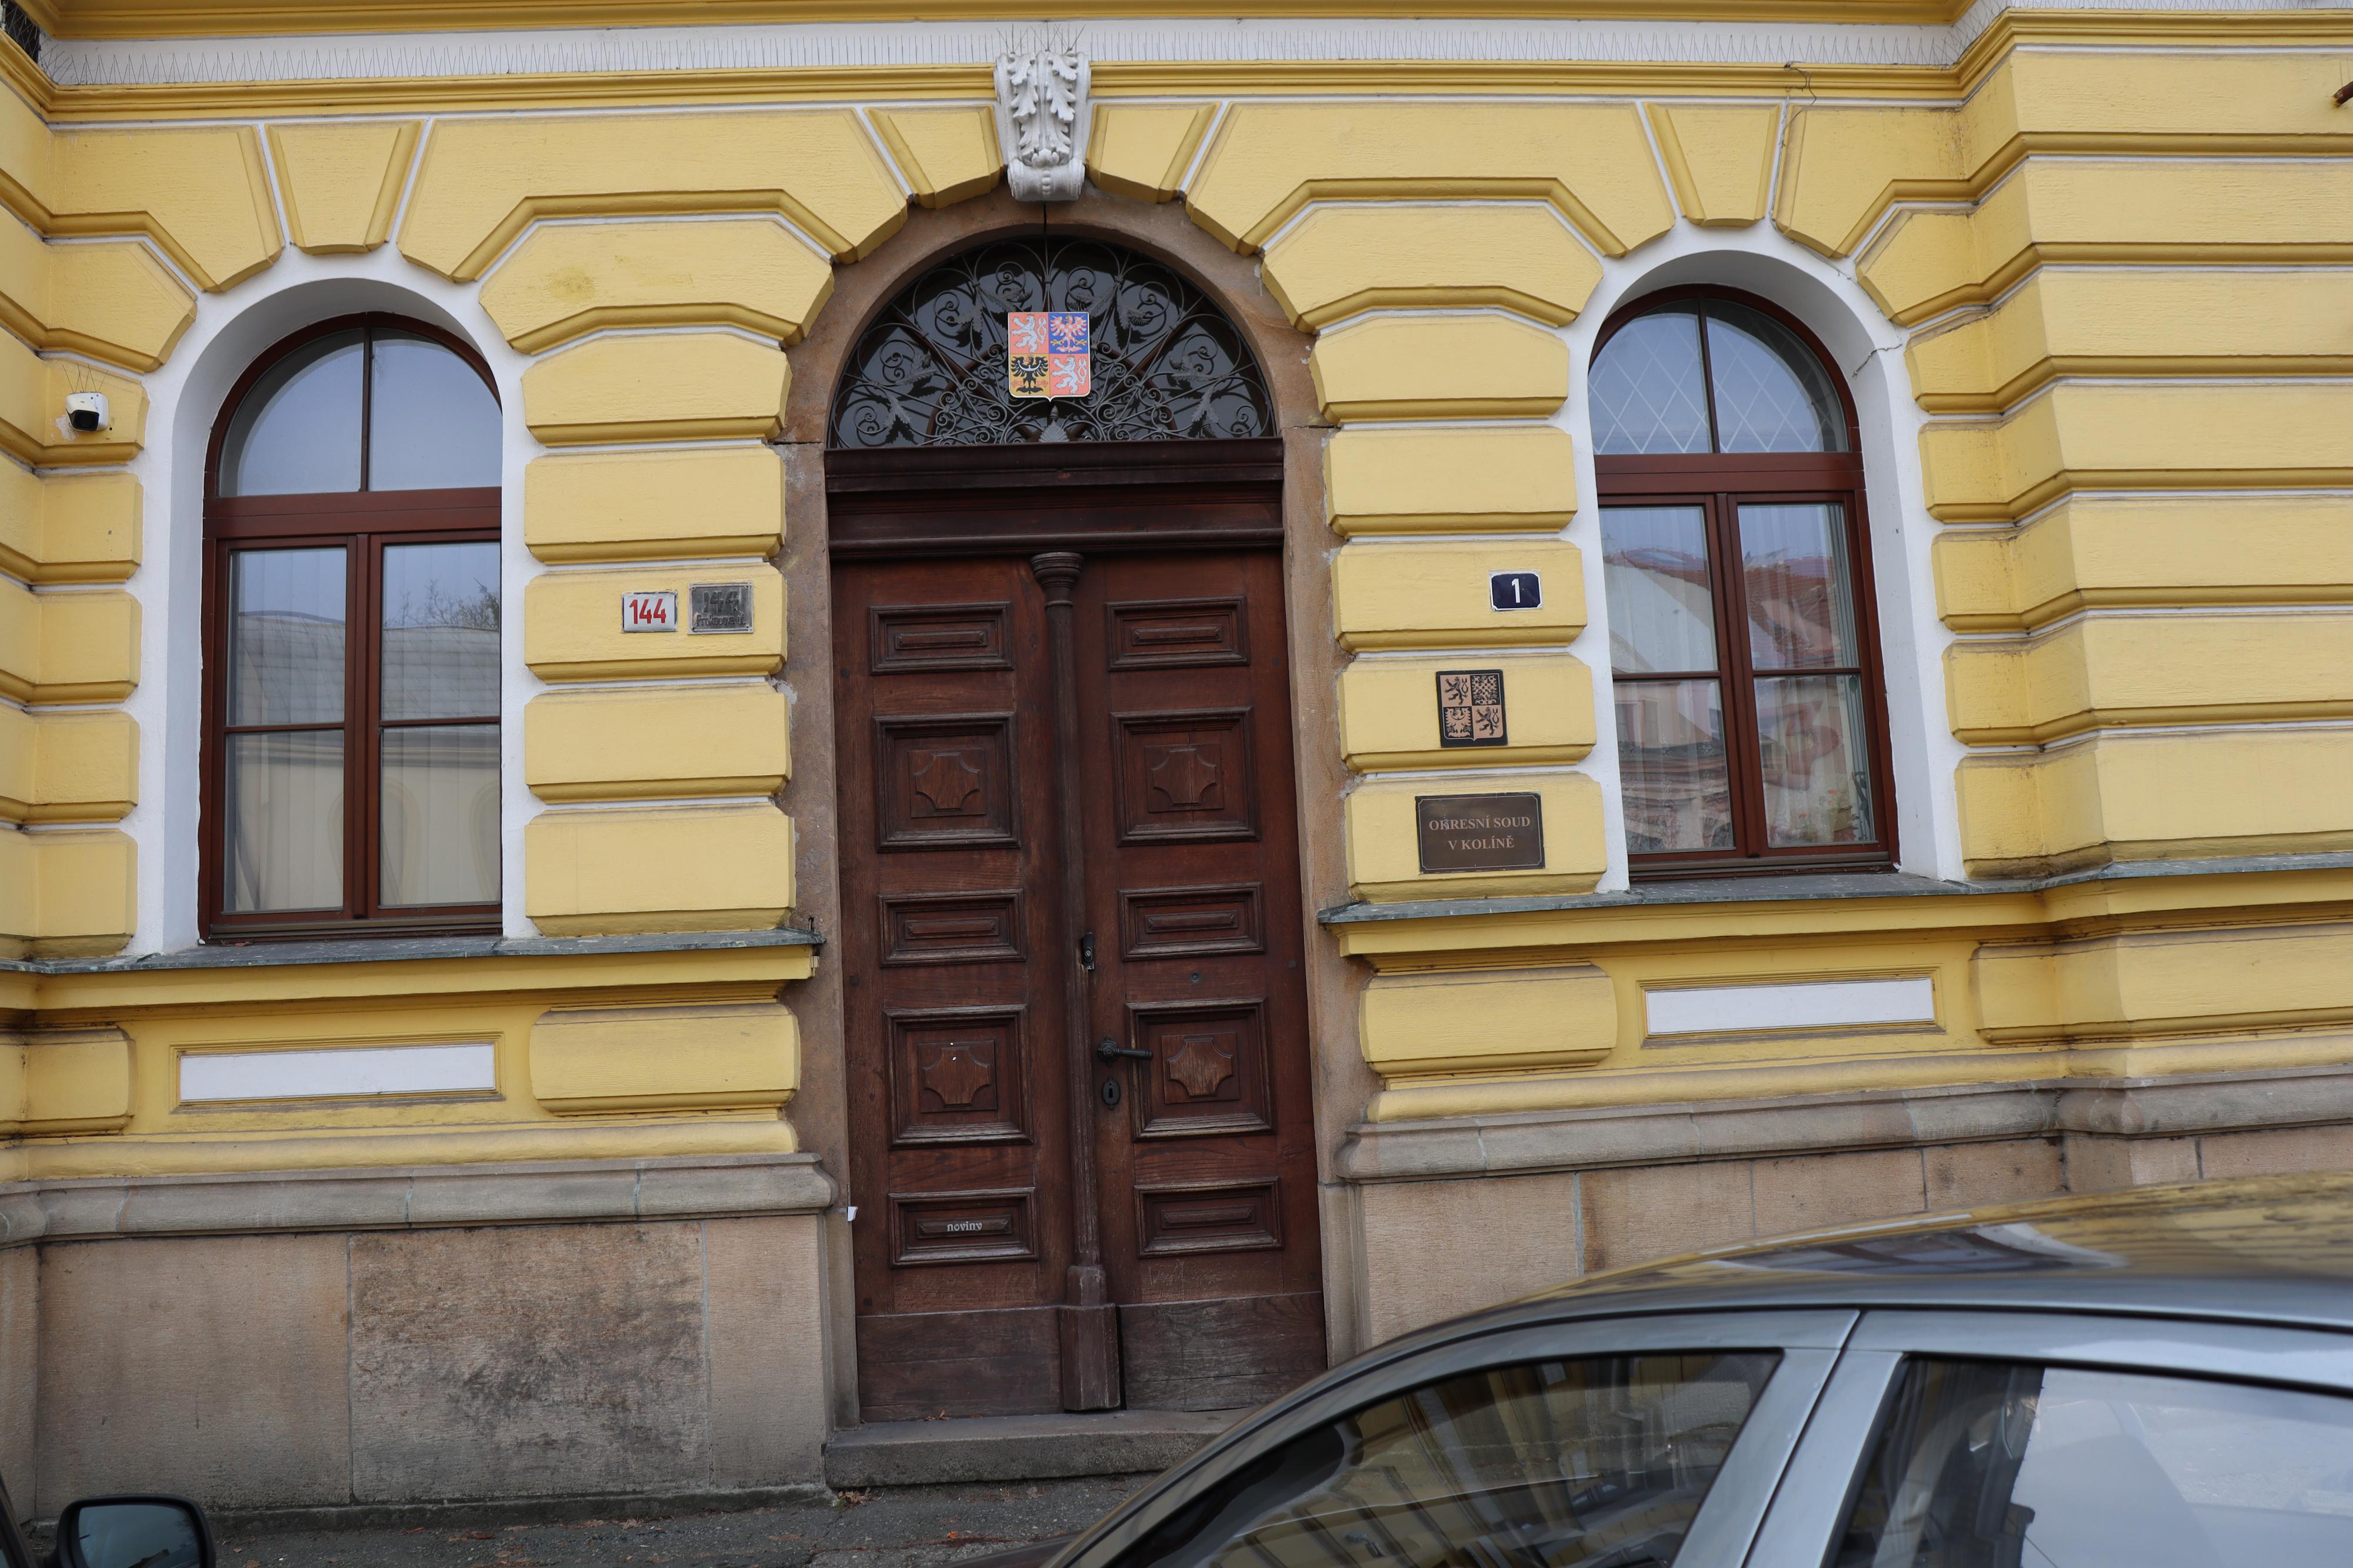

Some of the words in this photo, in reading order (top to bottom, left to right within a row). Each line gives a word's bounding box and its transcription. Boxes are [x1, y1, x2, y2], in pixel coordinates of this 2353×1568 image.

[1511, 578, 1521, 603] 1
[704, 590, 739, 612] 144
[629, 598, 666, 625] 144
[1429, 815, 1491, 831] OKRESNÍ
[1494, 816, 1531, 829] SOUD
[1448, 840, 1458, 850] V
[1461, 835, 1515, 850] KOLÍNĚ
[946, 1221, 982, 1233] noviny
